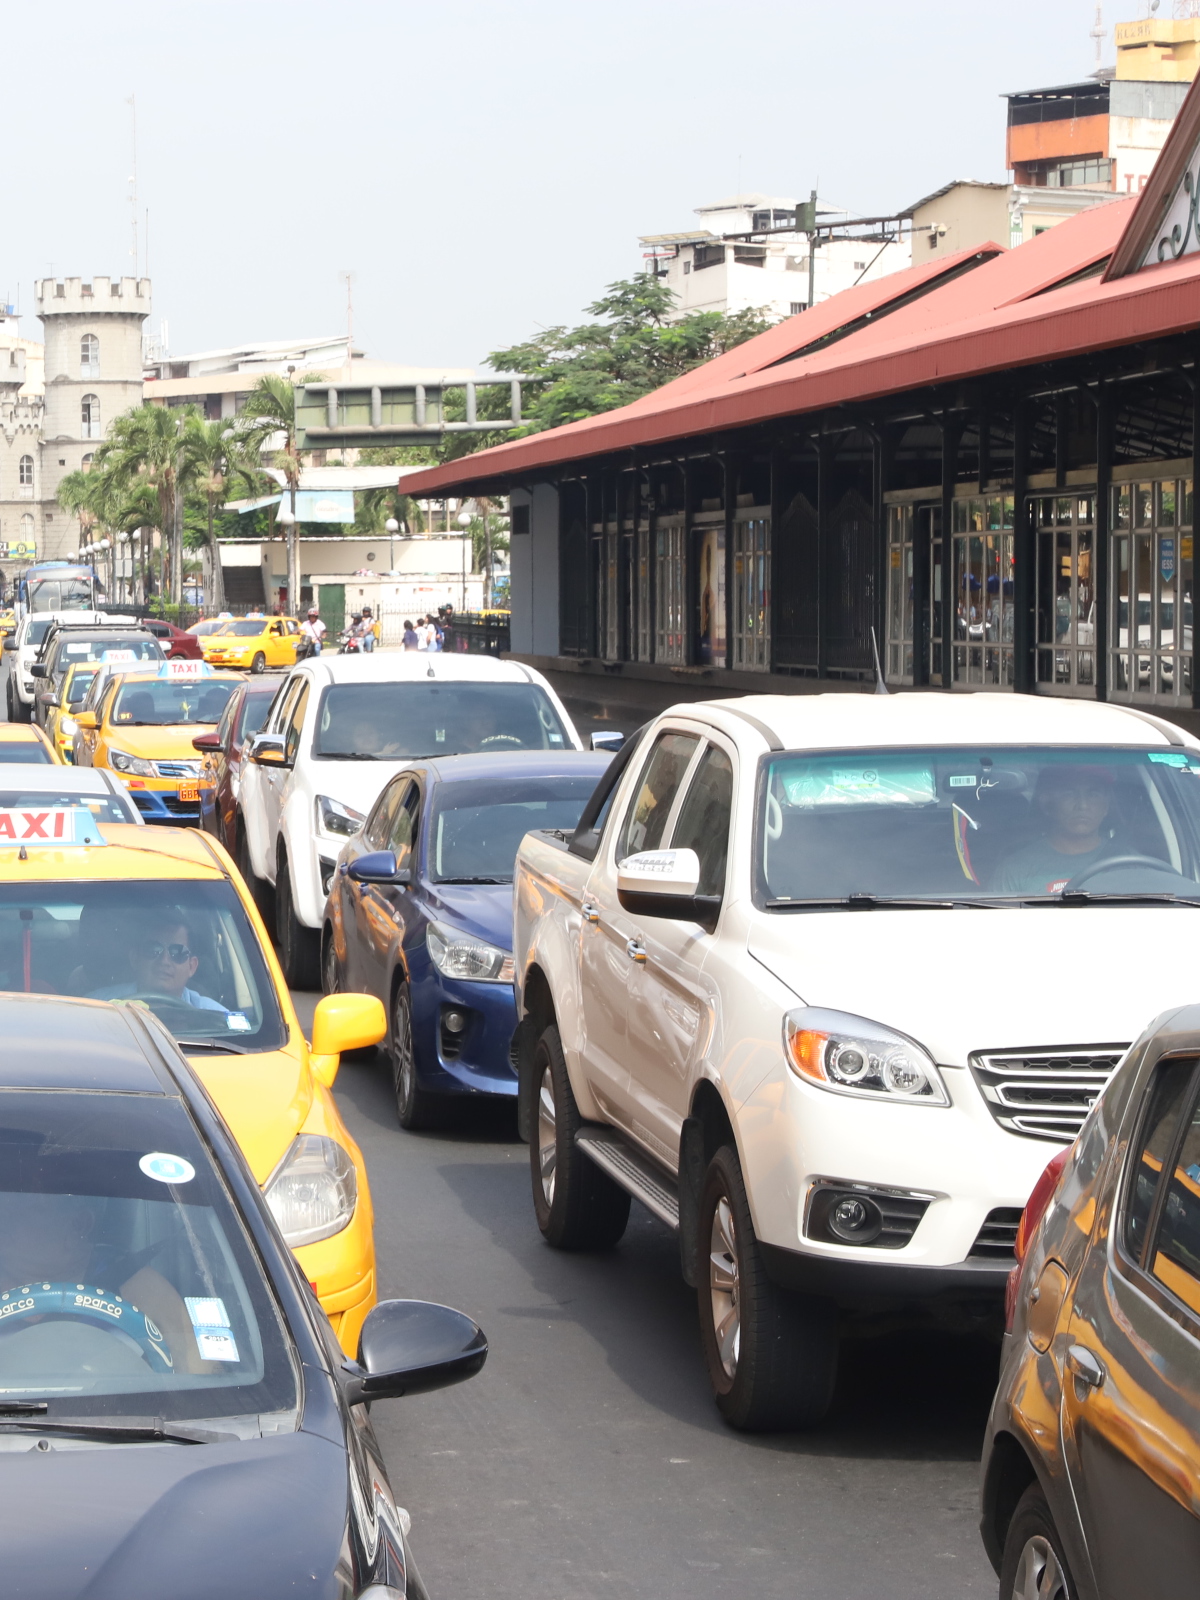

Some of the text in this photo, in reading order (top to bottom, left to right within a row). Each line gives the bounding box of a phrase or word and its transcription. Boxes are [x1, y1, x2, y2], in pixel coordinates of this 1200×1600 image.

[1162, 560, 1173, 569] IESS
[171, 664, 197, 673] TAXI
[75, 1295, 123, 1317] sparco
